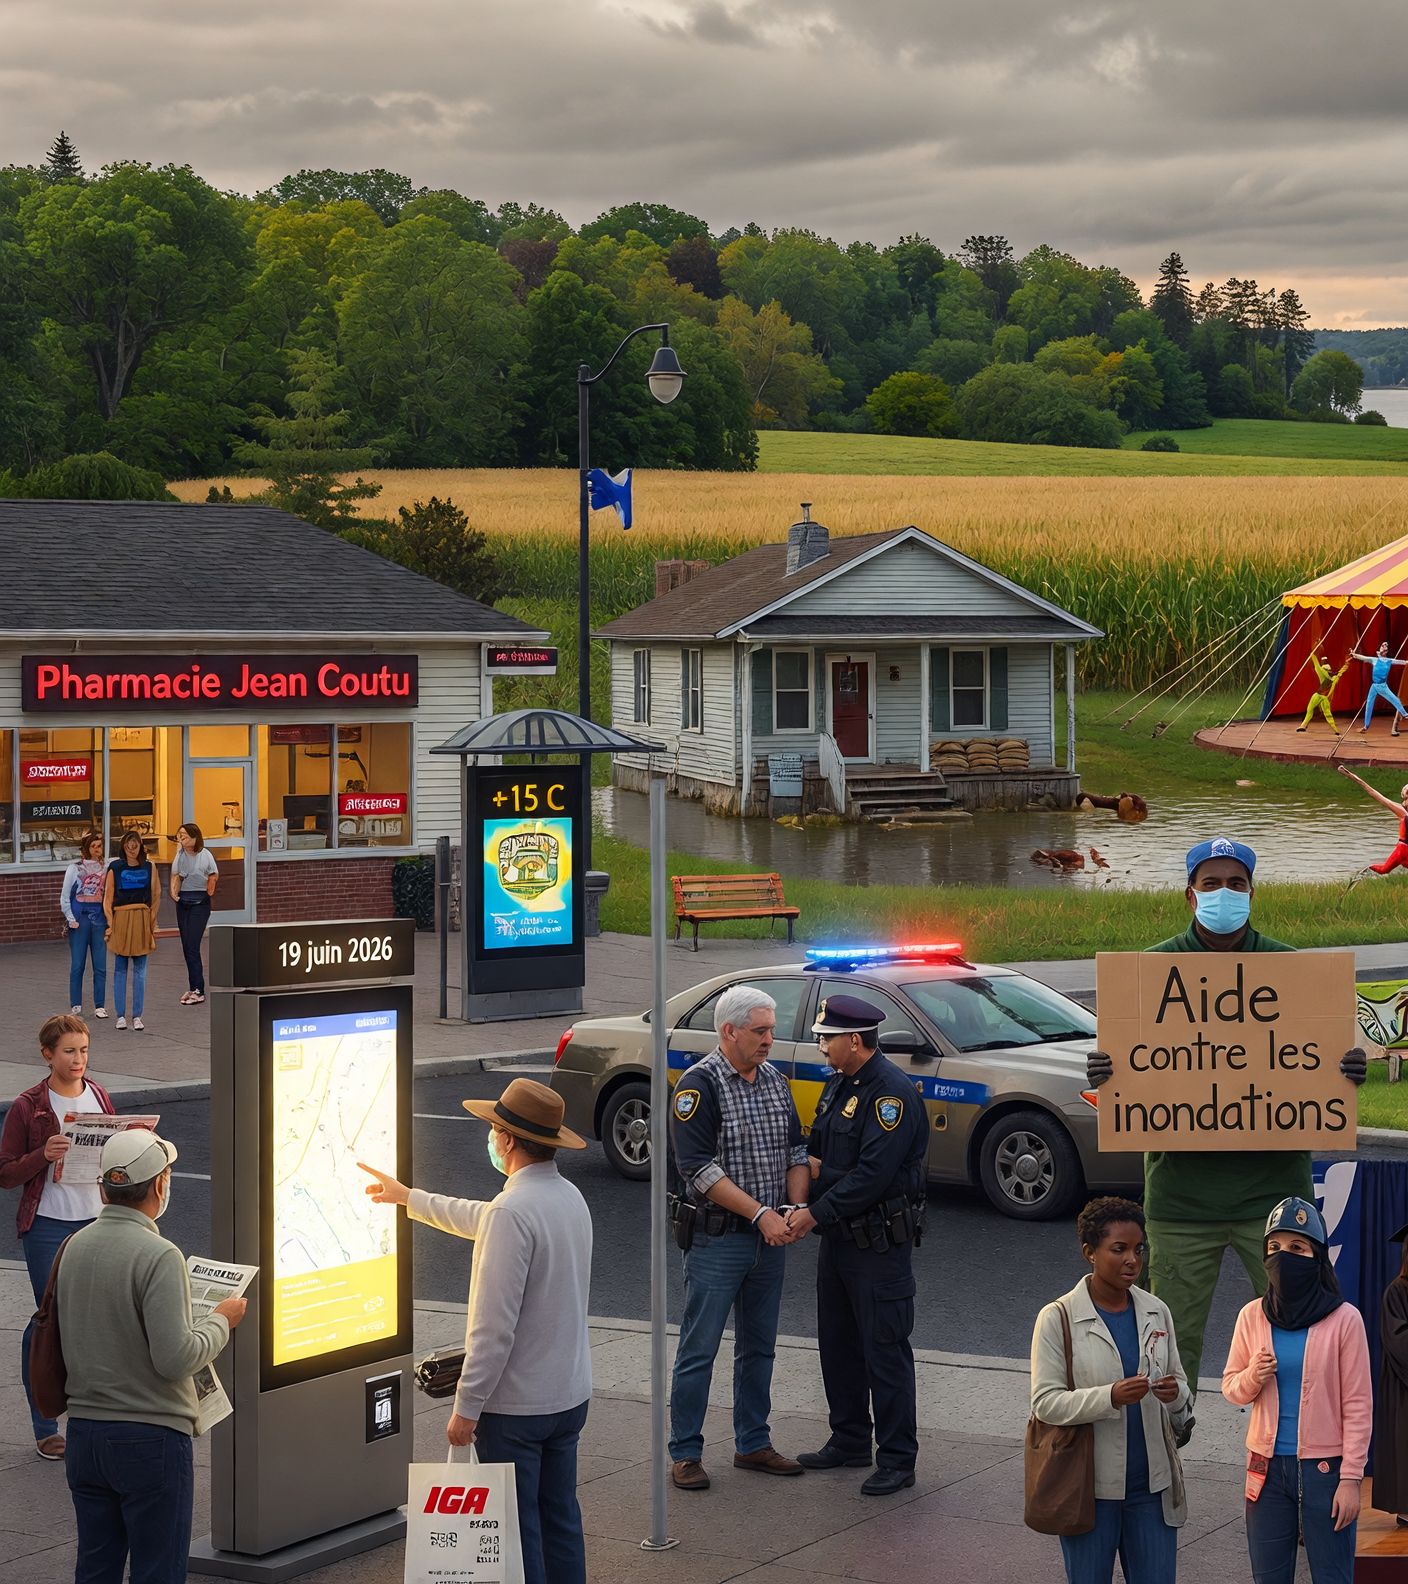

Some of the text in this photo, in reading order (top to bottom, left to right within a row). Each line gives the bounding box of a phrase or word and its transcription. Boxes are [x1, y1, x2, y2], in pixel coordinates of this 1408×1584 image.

[36, 662, 410, 700] Pharmacie Jean Coutu
[492, 784, 565, 812] +15 C
[278, 936, 393, 971] 19 juin 2026
[1155, 962, 1280, 1025] Aide
[1129, 1029, 1321, 1072] contre les
[1114, 1082, 1347, 1133] inondations
[423, 1486, 490, 1515] IGA
